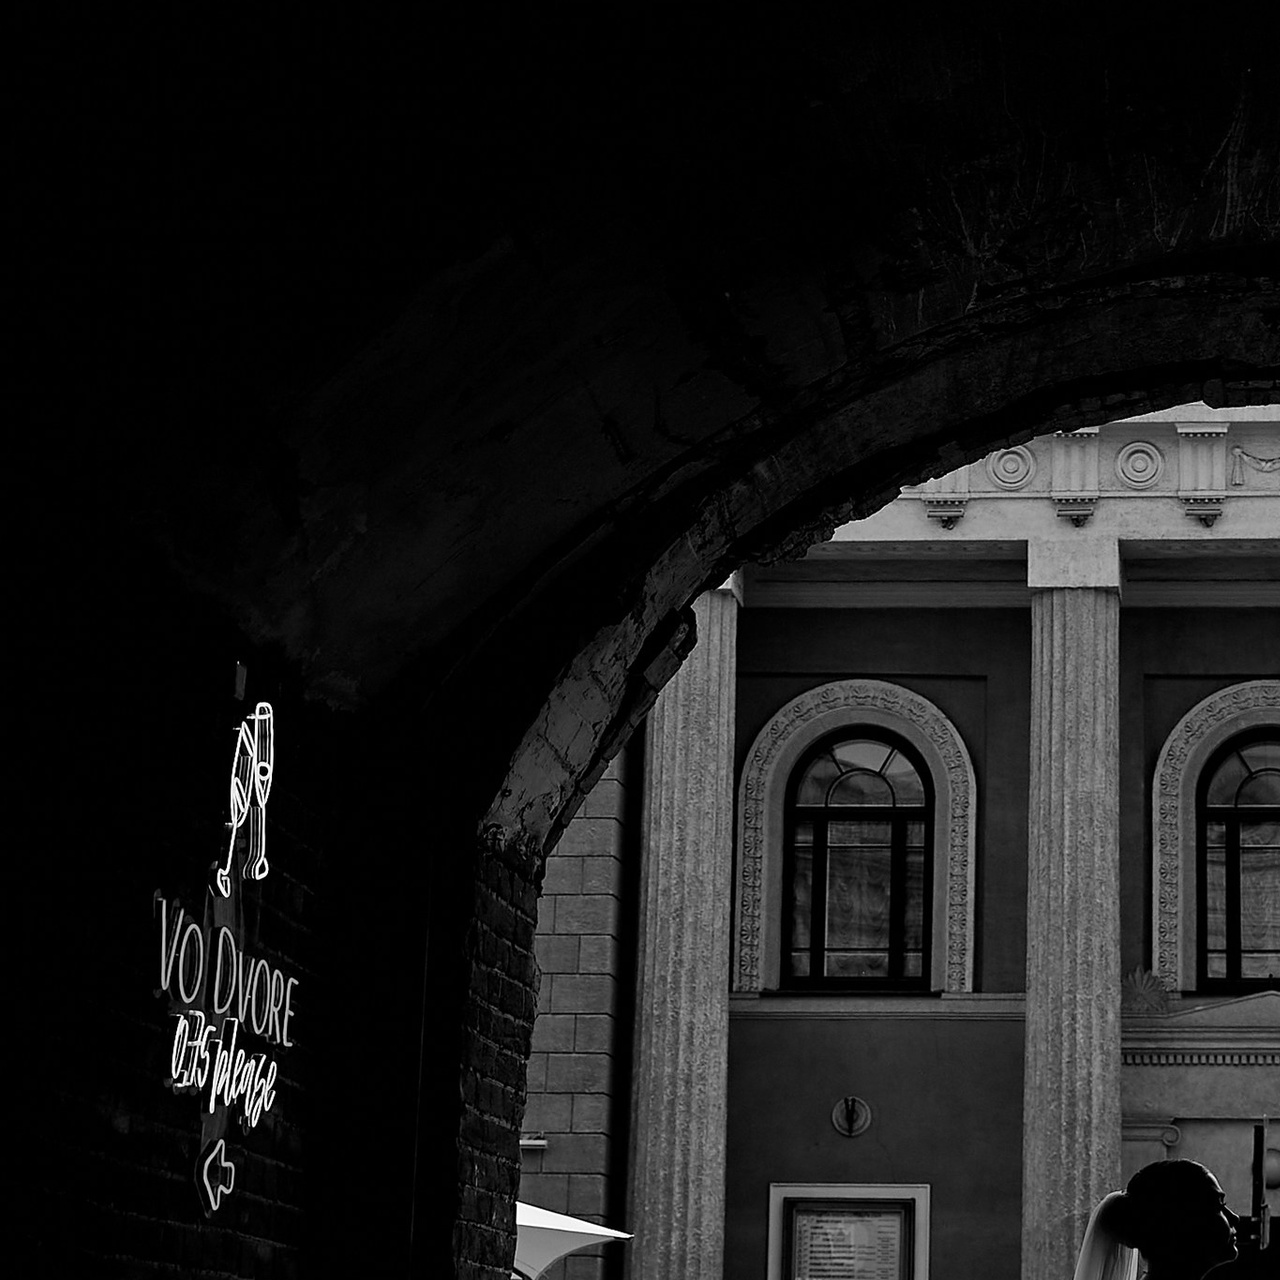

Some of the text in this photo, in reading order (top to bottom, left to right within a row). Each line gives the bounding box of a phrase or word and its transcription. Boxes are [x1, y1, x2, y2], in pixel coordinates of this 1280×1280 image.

[161, 897, 299, 1047] VO DVORE
[206, 1017, 277, 1128] please
